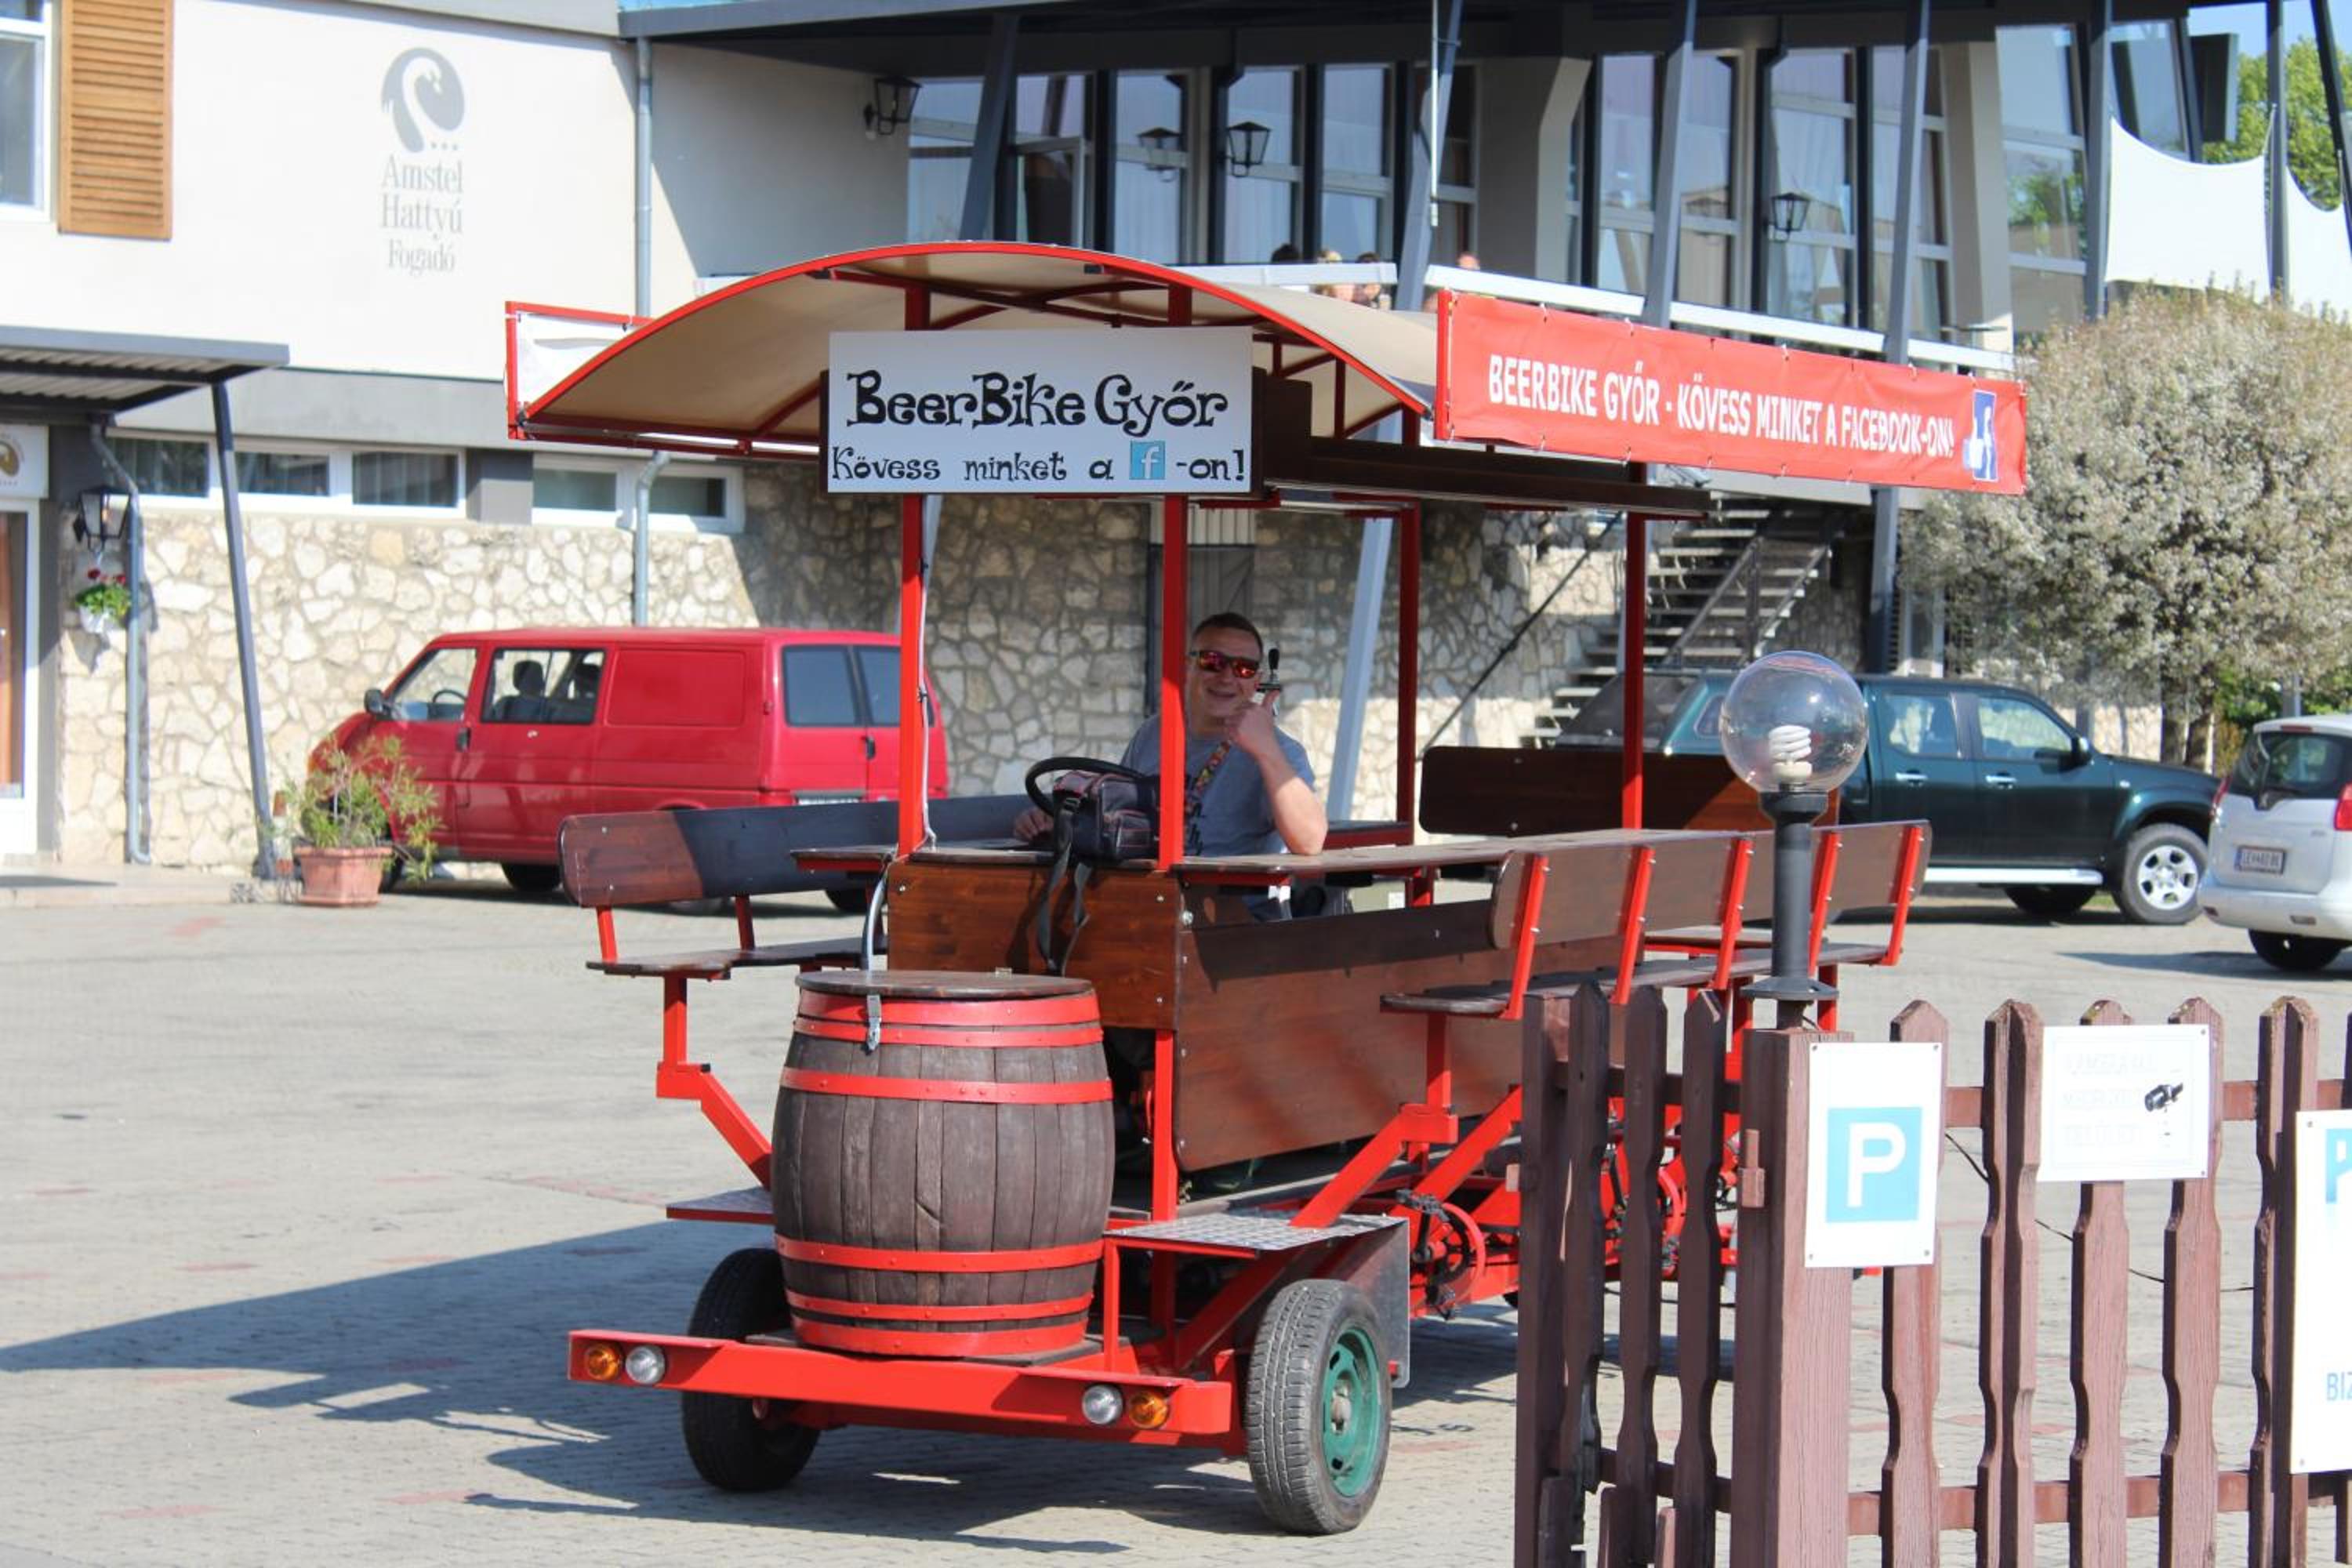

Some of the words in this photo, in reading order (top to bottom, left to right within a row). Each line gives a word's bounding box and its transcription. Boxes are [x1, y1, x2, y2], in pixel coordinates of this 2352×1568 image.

[381, 154, 463, 194] Amstel
[380, 193, 463, 241] Hattyú
[388, 238, 455, 278] Fogadó
[846, 368, 1087, 429] BeerBike
[1094, 373, 1229, 437] Győr
[1488, 353, 1598, 418] BEERBIKE
[1676, 372, 1752, 437] KÖVESS
[1755, 394, 1824, 445] MINKET
[1825, 403, 1838, 447] A
[1841, 405, 1955, 458] FACEBOOK-ON!
[832, 445, 941, 481] Kövess
[964, 452, 1068, 481] minket
[1088, 459, 1115, 481] a
[1175, 448, 1246, 481] -on!
[1846, 1121, 1906, 1208] P
